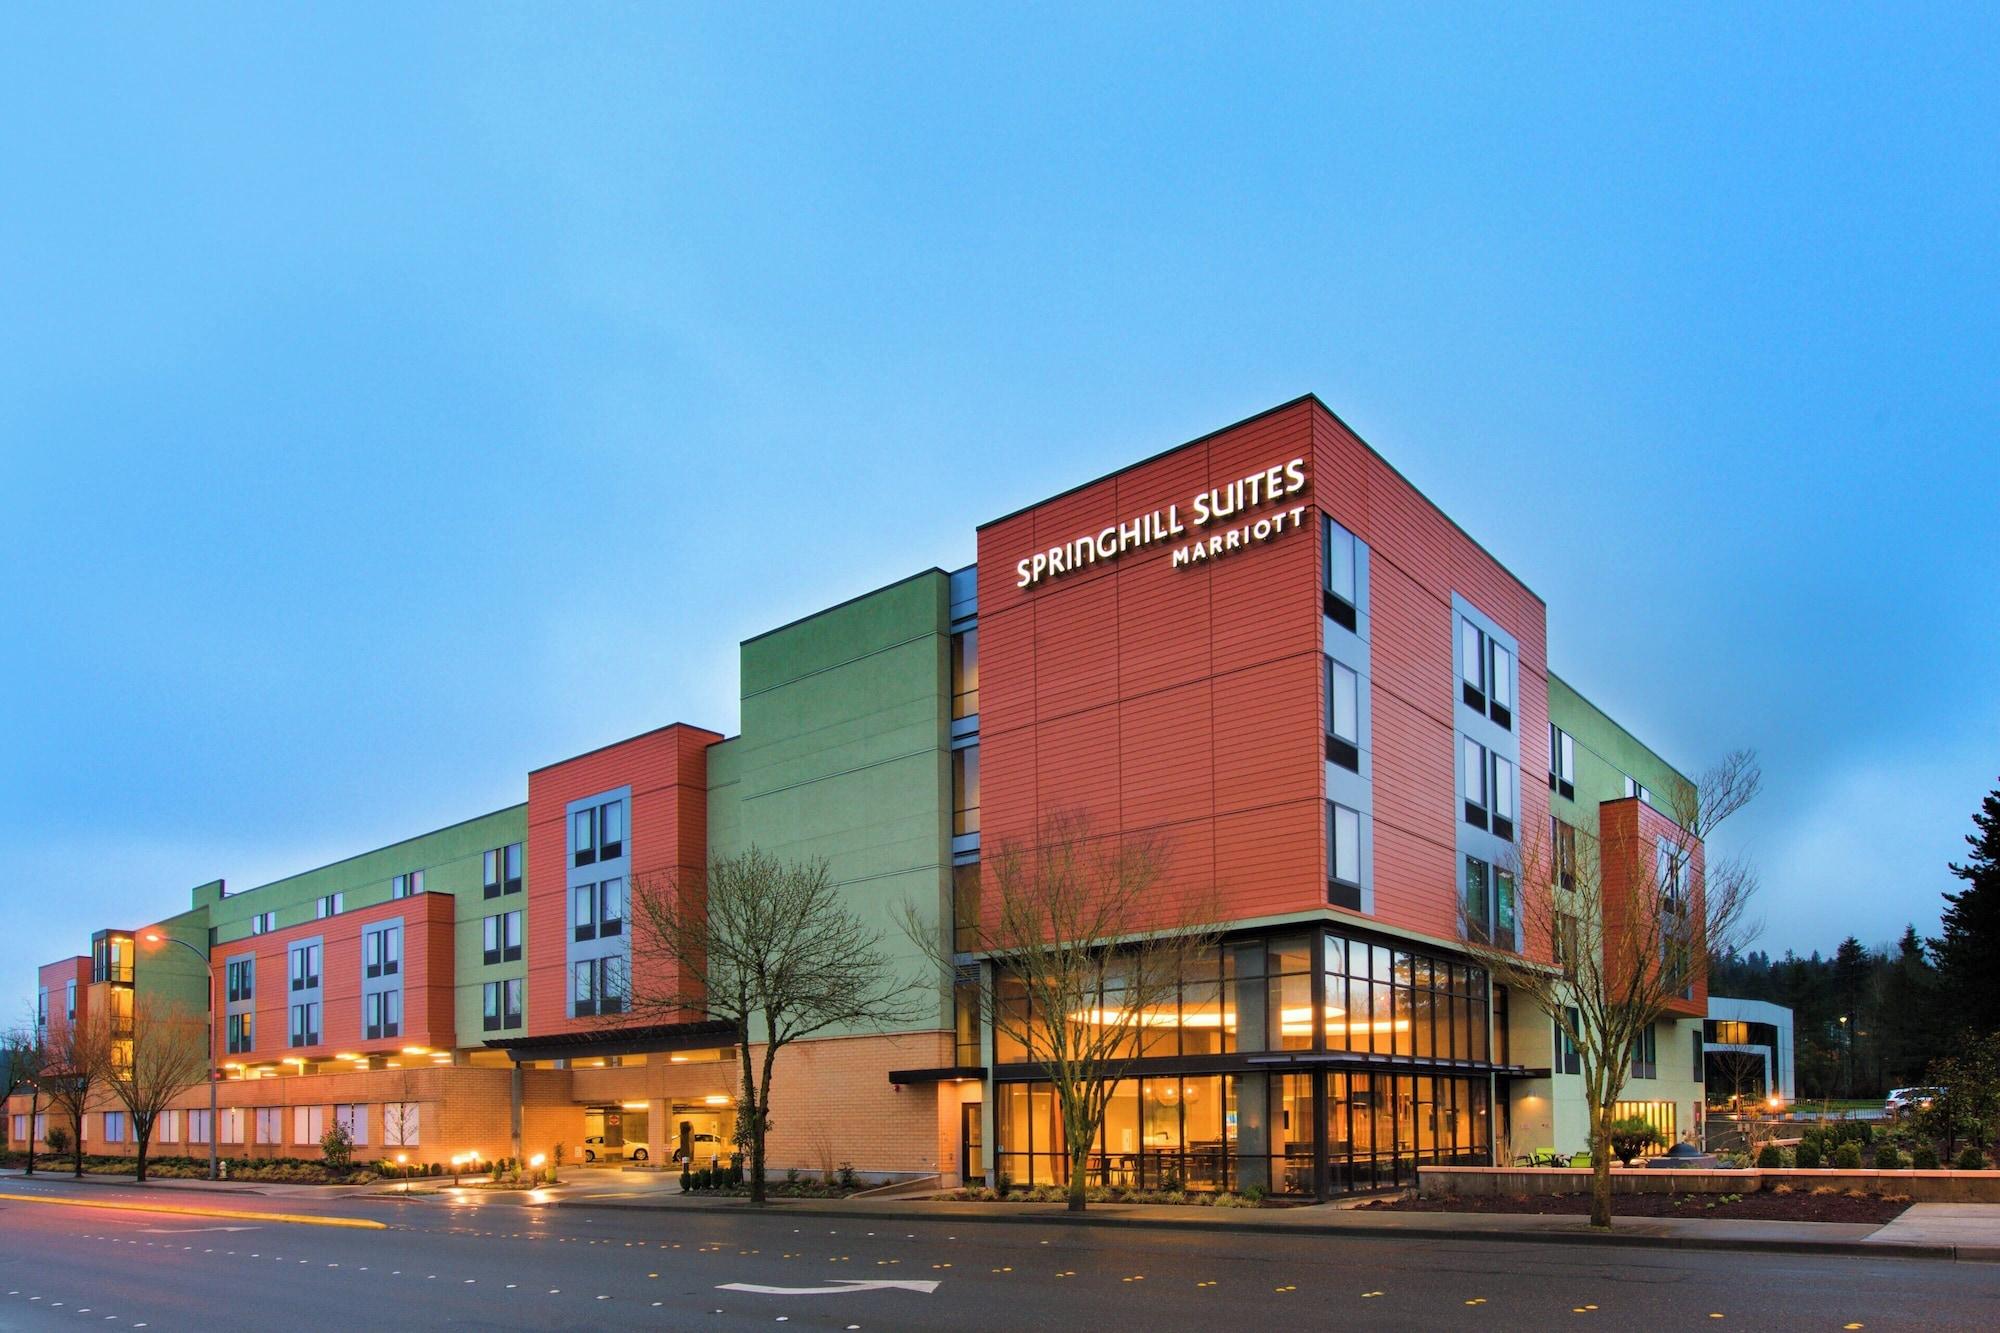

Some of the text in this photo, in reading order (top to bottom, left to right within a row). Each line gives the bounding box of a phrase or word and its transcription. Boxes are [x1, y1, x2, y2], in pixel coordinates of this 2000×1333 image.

[1017, 458, 1305, 588] SPRINGHILL SUITES
[1172, 506, 1305, 568] MARRIOTT
